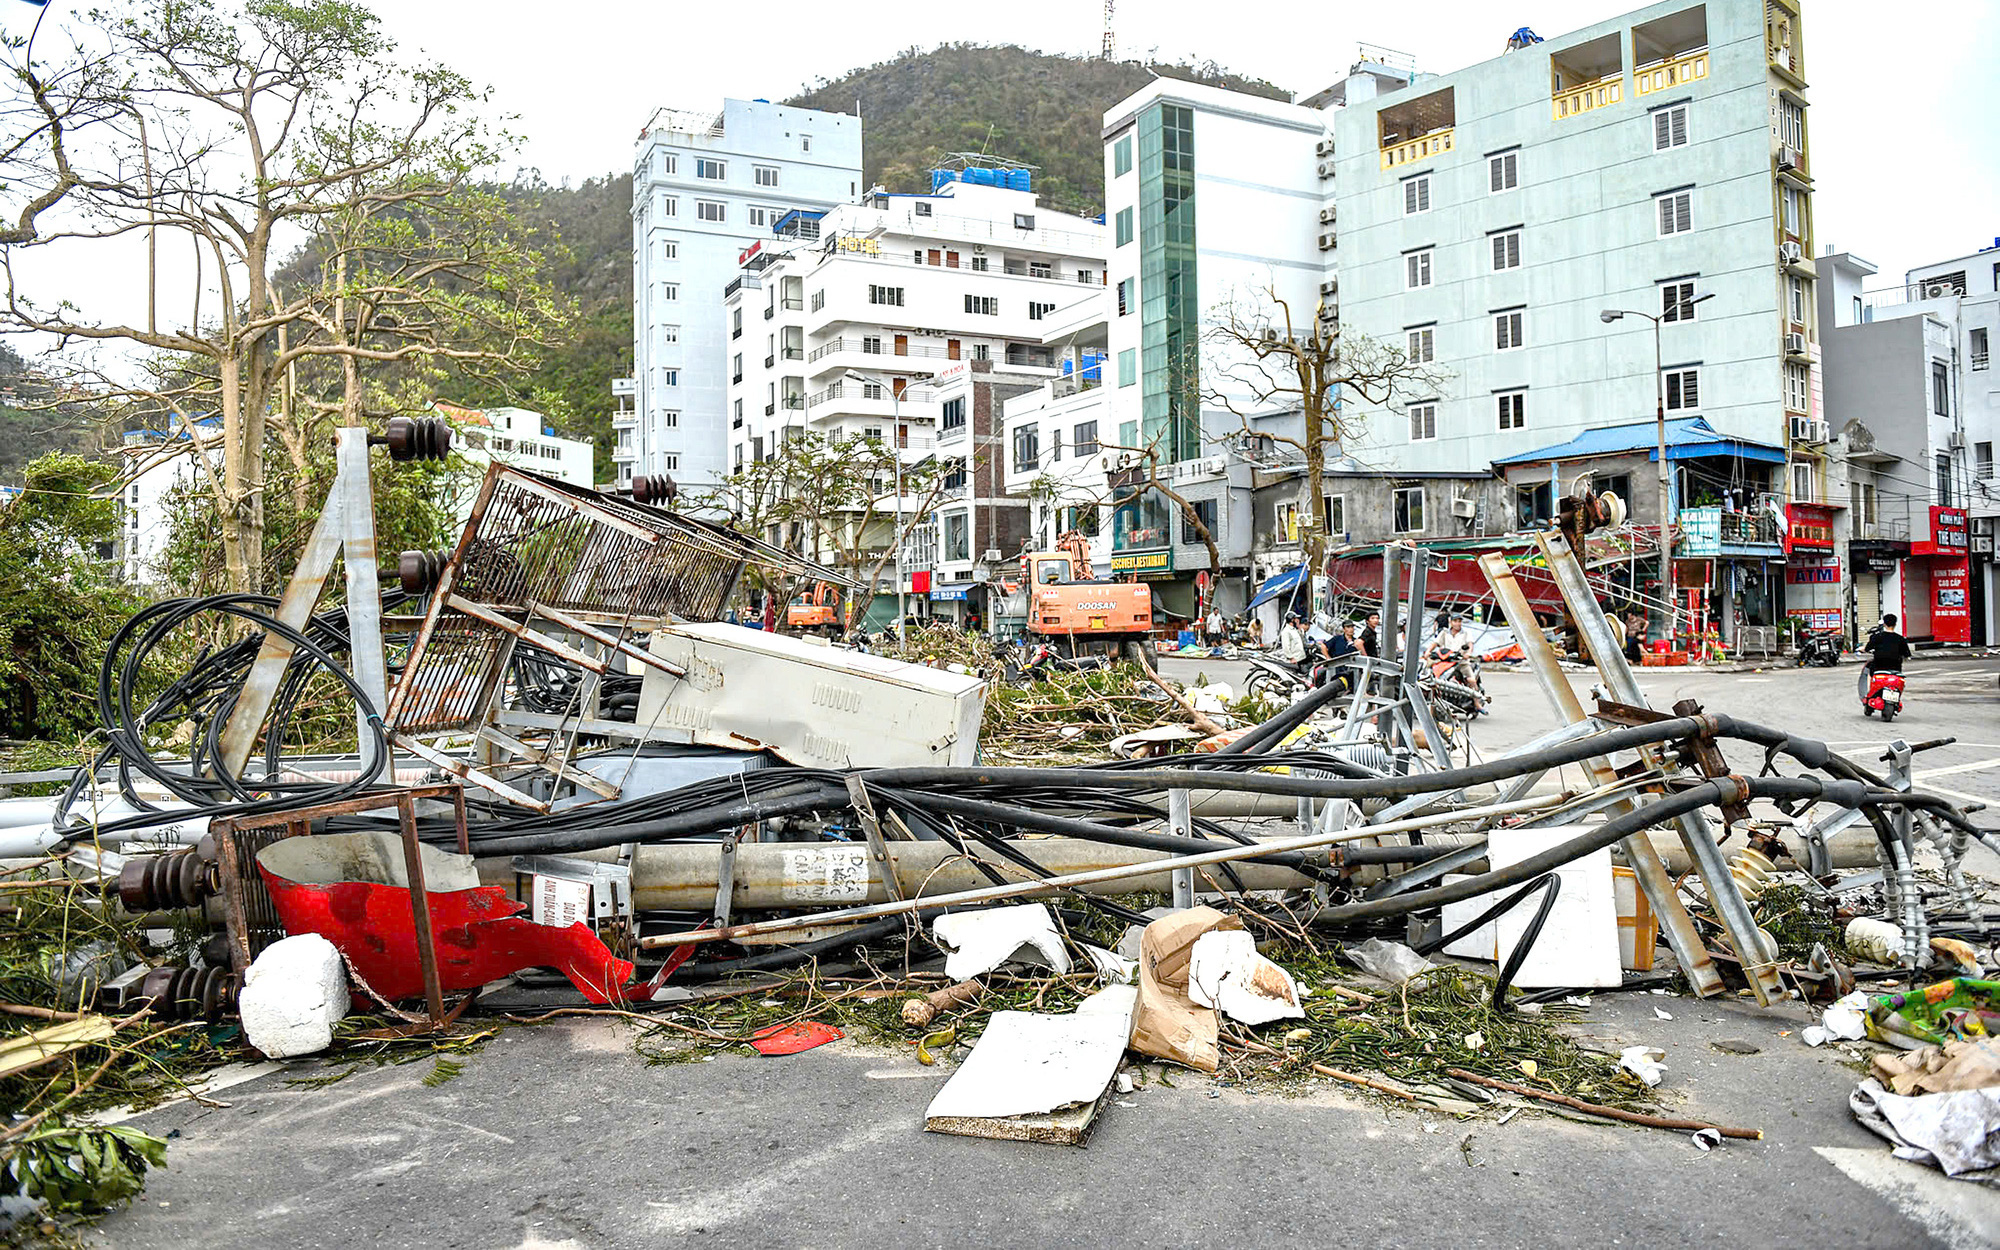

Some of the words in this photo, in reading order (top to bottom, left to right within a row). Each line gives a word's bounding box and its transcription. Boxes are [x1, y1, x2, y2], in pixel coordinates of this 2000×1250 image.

[838, 236, 881, 254] HOTEL
[1136, 554, 1167, 567] RESTAURANT
[1796, 569, 1833, 581] ATM
[1077, 602, 1117, 610] DOOSAN
[545, 879, 556, 893] ANH
